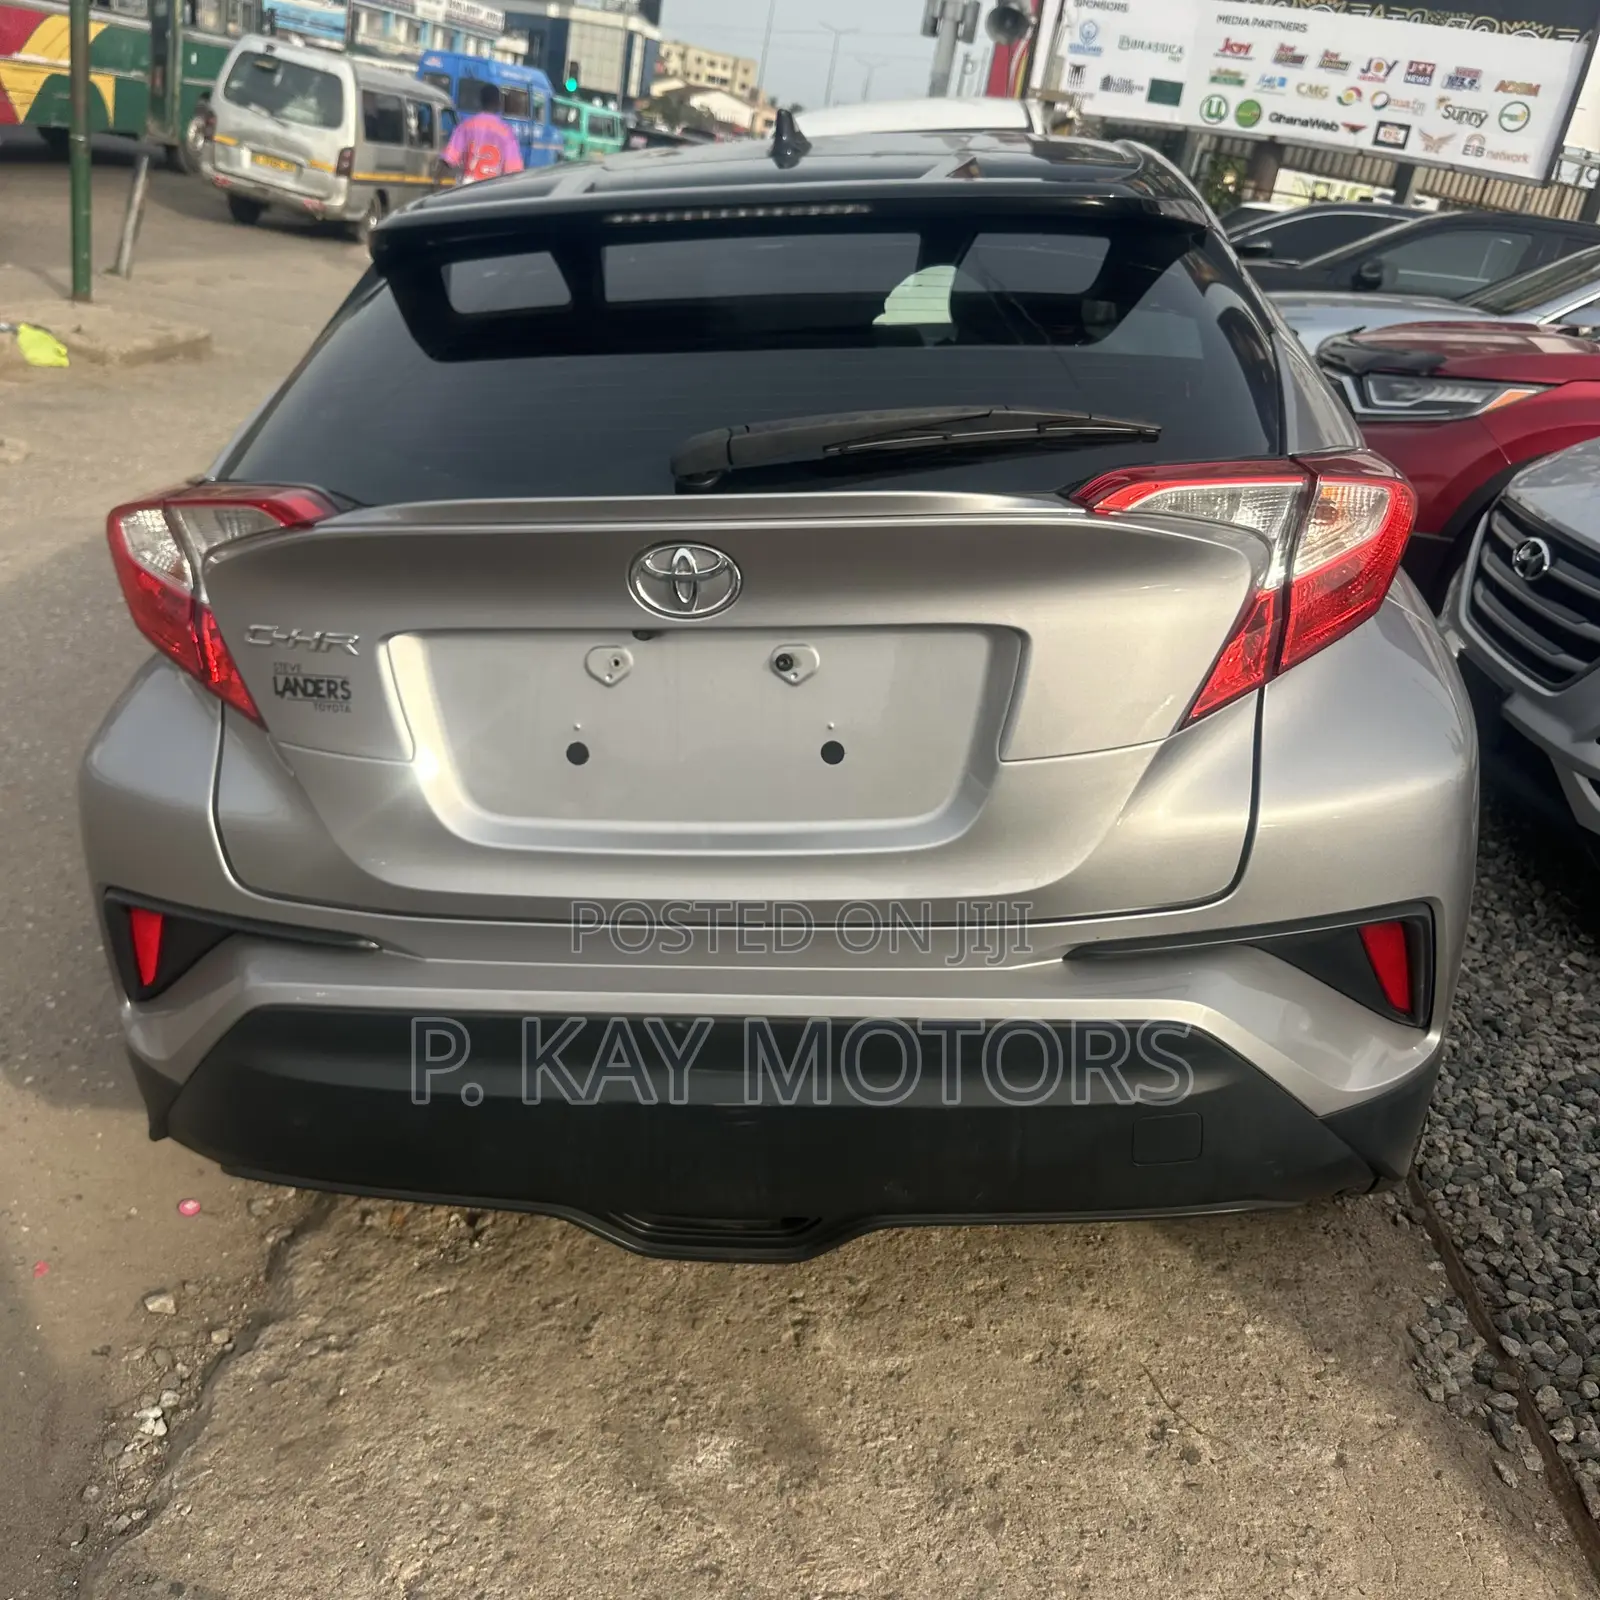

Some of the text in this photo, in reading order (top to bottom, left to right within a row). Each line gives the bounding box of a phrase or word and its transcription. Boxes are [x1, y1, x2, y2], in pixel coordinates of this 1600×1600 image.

[1217, 14, 1308, 33] MEDIA PARTNERS
[1269, 112, 1339, 132] GhanaWeb
[1442, 104, 1489, 128] Sunny
[1486, 149, 1530, 164] network
[273, 676, 352, 701] LANDERS
[313, 702, 352, 714] TOYOTA
